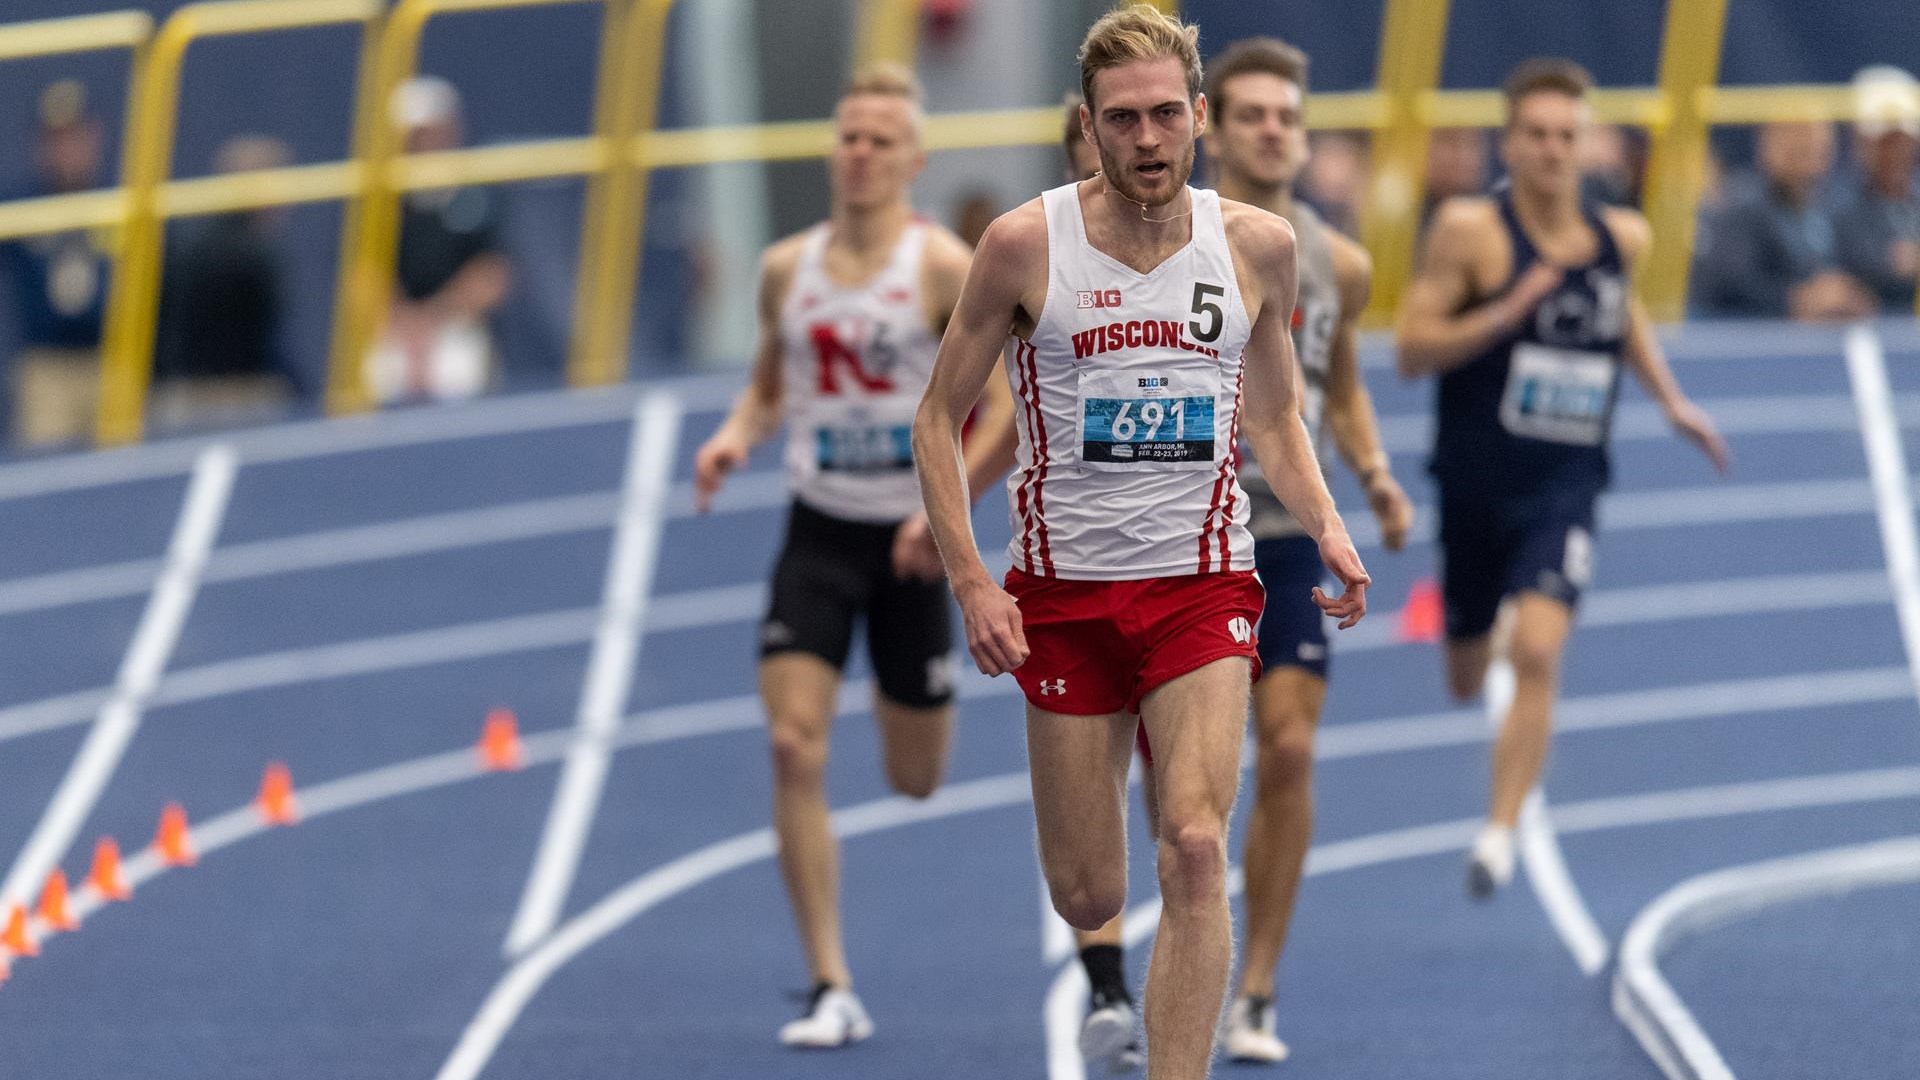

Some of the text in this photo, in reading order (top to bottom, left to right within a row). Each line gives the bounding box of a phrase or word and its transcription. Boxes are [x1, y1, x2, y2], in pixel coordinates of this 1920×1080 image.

[1188, 281, 1225, 343] 5
[1071, 319, 1219, 359] WISCON
[1111, 401, 1186, 441] 691
